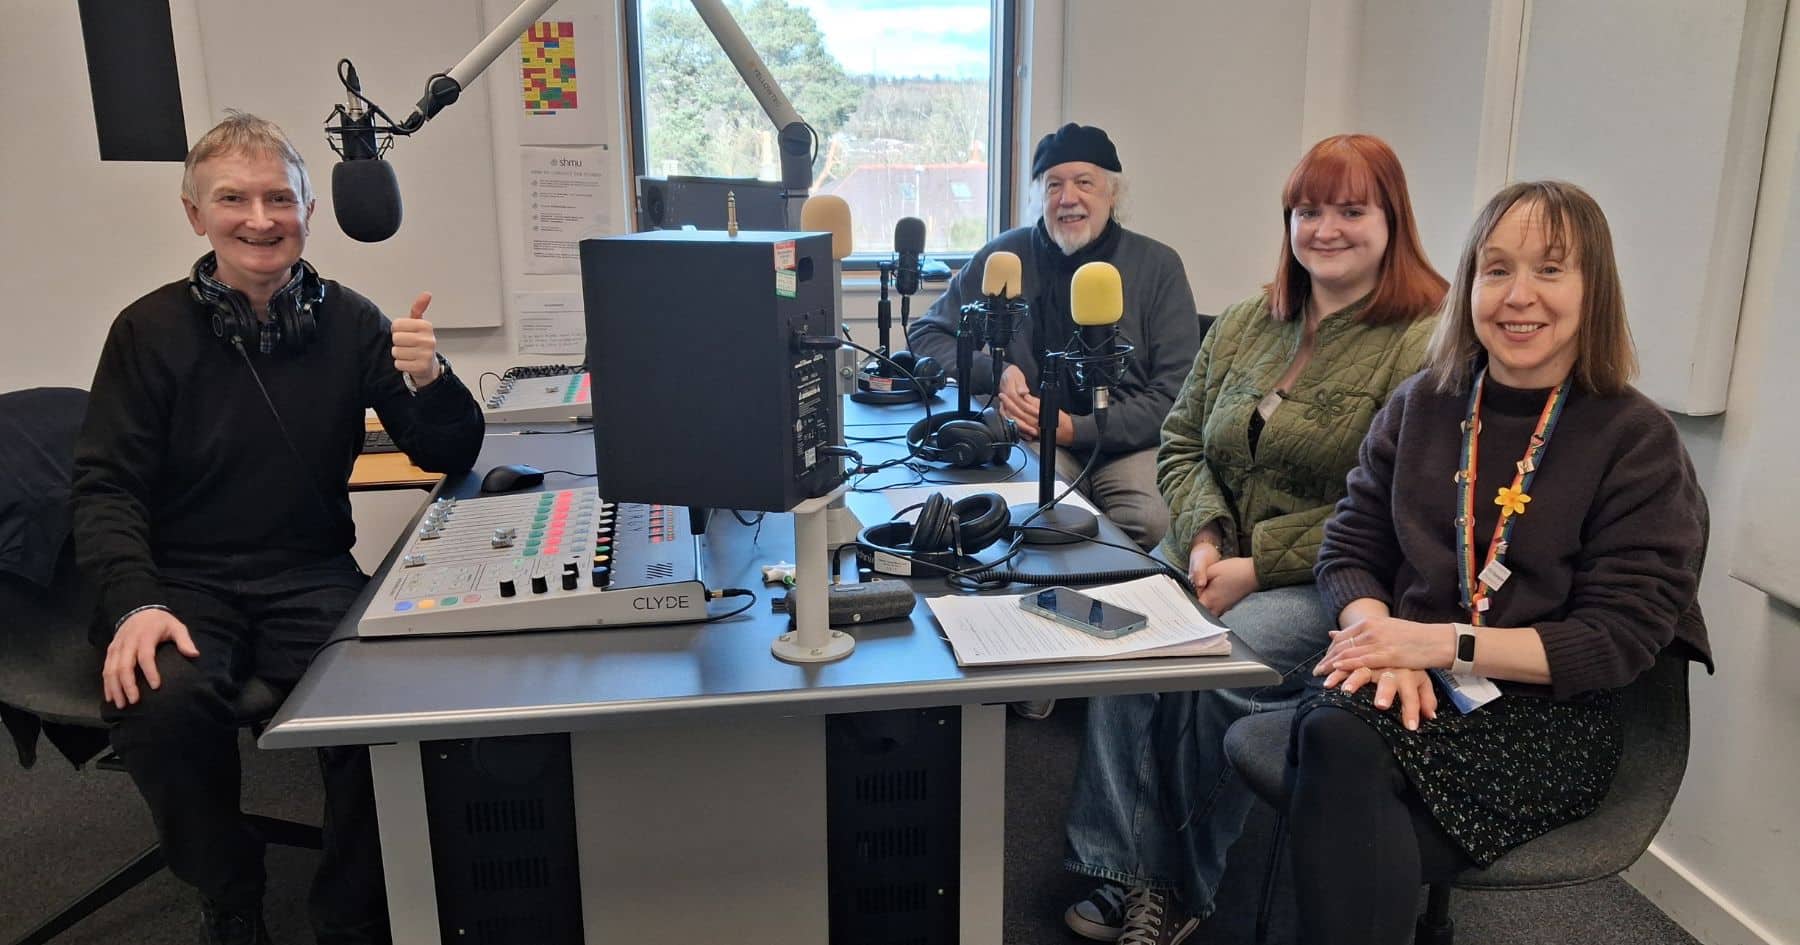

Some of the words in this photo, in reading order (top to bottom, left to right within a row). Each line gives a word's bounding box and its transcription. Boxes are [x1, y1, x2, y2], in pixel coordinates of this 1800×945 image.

[753, 68, 781, 106] YELLOWTE
[559, 156, 583, 168] shmu
[632, 595, 689, 610] CLYDE
